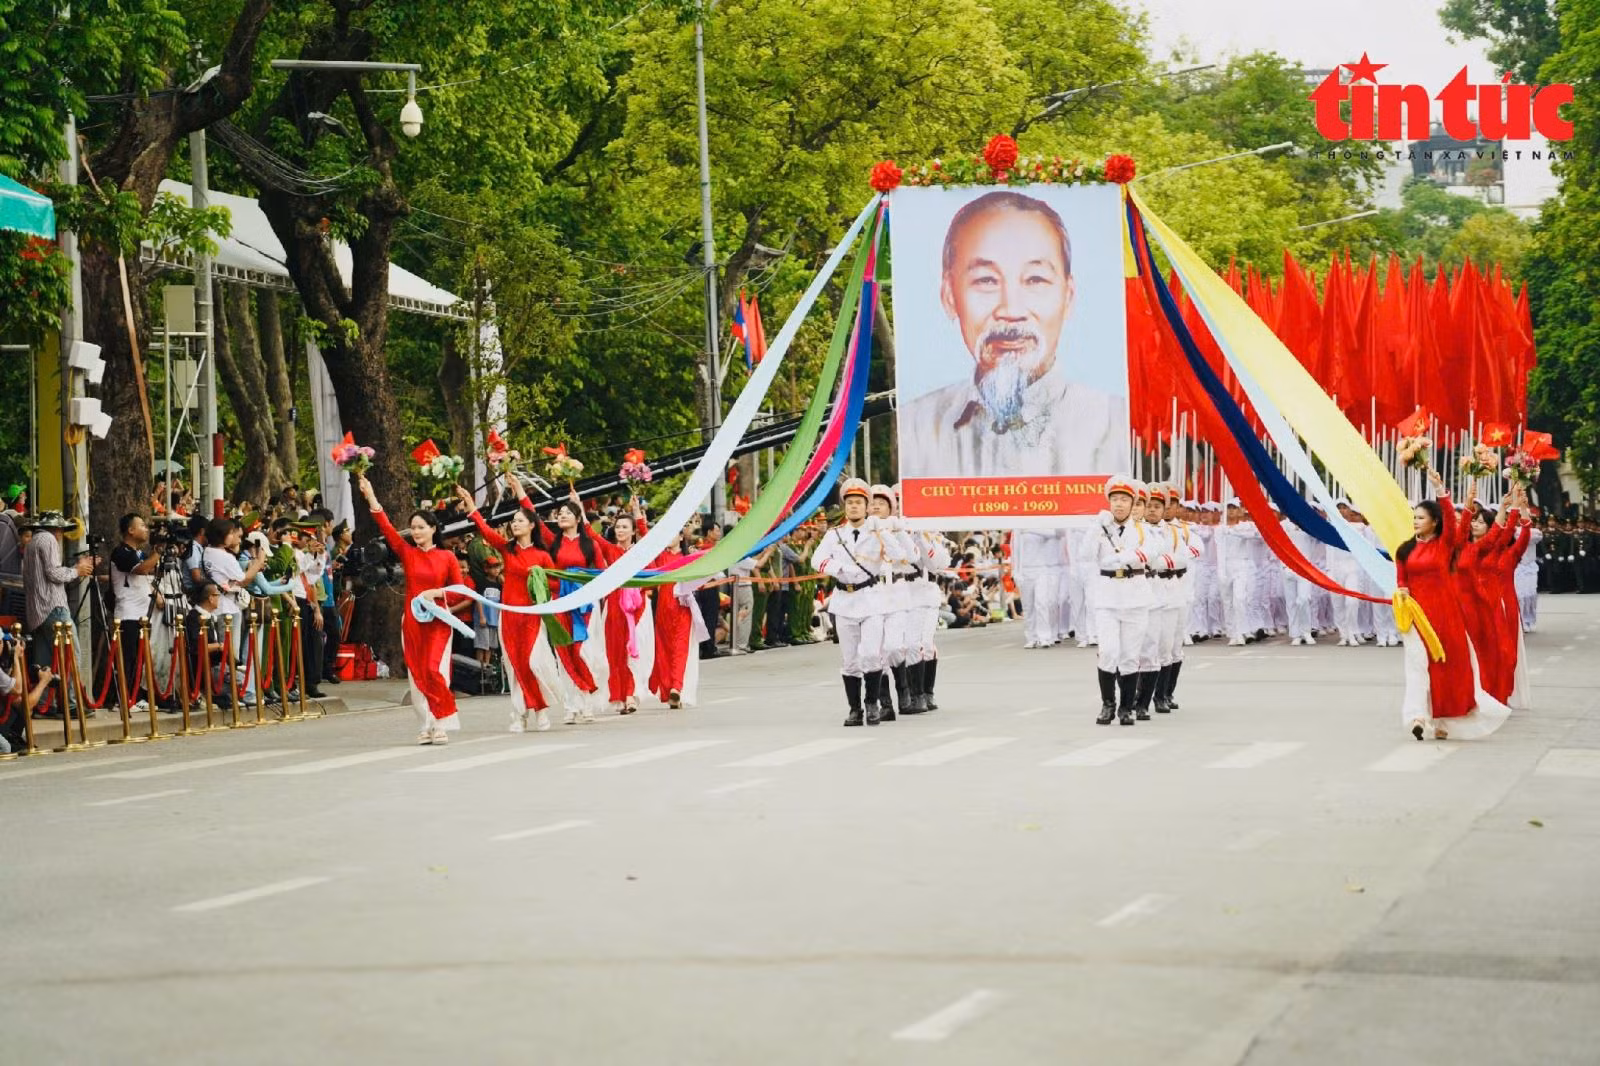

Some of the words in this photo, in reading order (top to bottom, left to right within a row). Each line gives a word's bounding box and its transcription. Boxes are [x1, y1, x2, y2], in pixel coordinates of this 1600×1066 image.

[921, 483, 956, 497] CHỦ
[959, 485, 999, 498] TỊCH
[1004, 480, 1028, 495] HỒ
[1031, 480, 1061, 495] CHÍ
[972, 501, 1009, 513] (1890
[1023, 500, 1059, 512] 1969)
